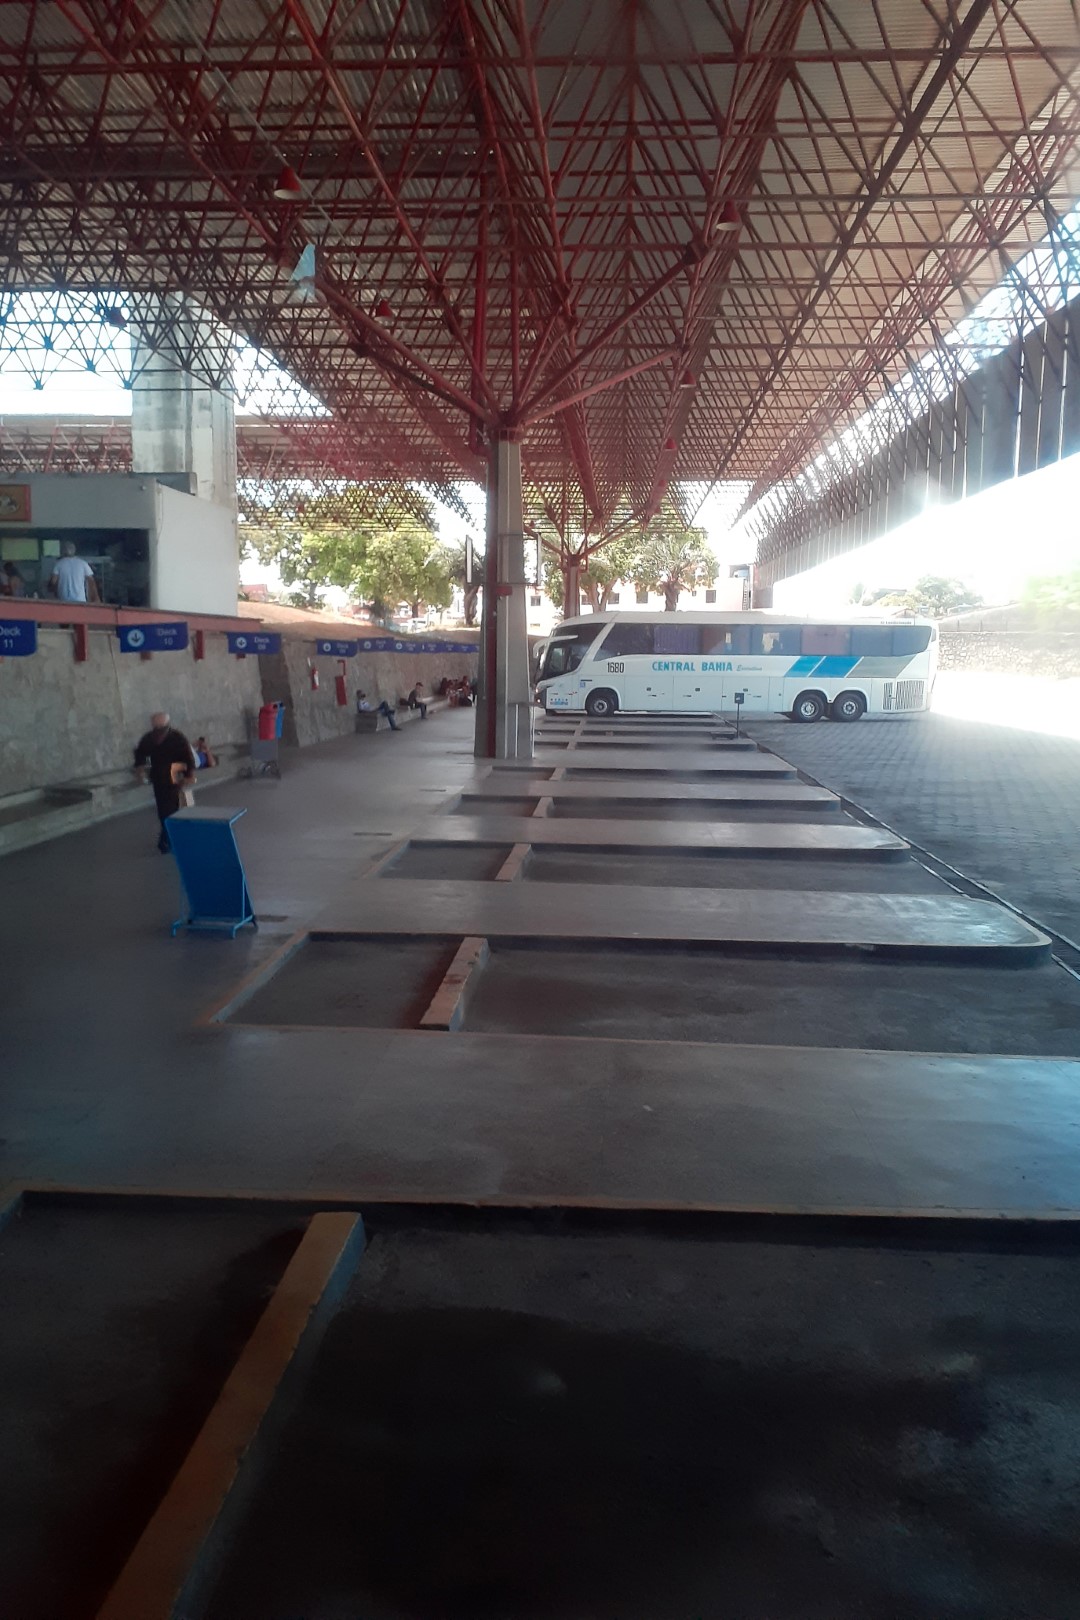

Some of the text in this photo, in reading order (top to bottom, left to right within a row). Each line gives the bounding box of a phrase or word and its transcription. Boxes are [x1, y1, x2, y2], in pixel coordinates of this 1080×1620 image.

[0, 625, 21, 637] Deck
[4, 638, 13, 648] 11
[607, 662, 625, 673] 1680
[652, 661, 696, 672] CENTRAL
[701, 662, 733, 672] BAHIA
